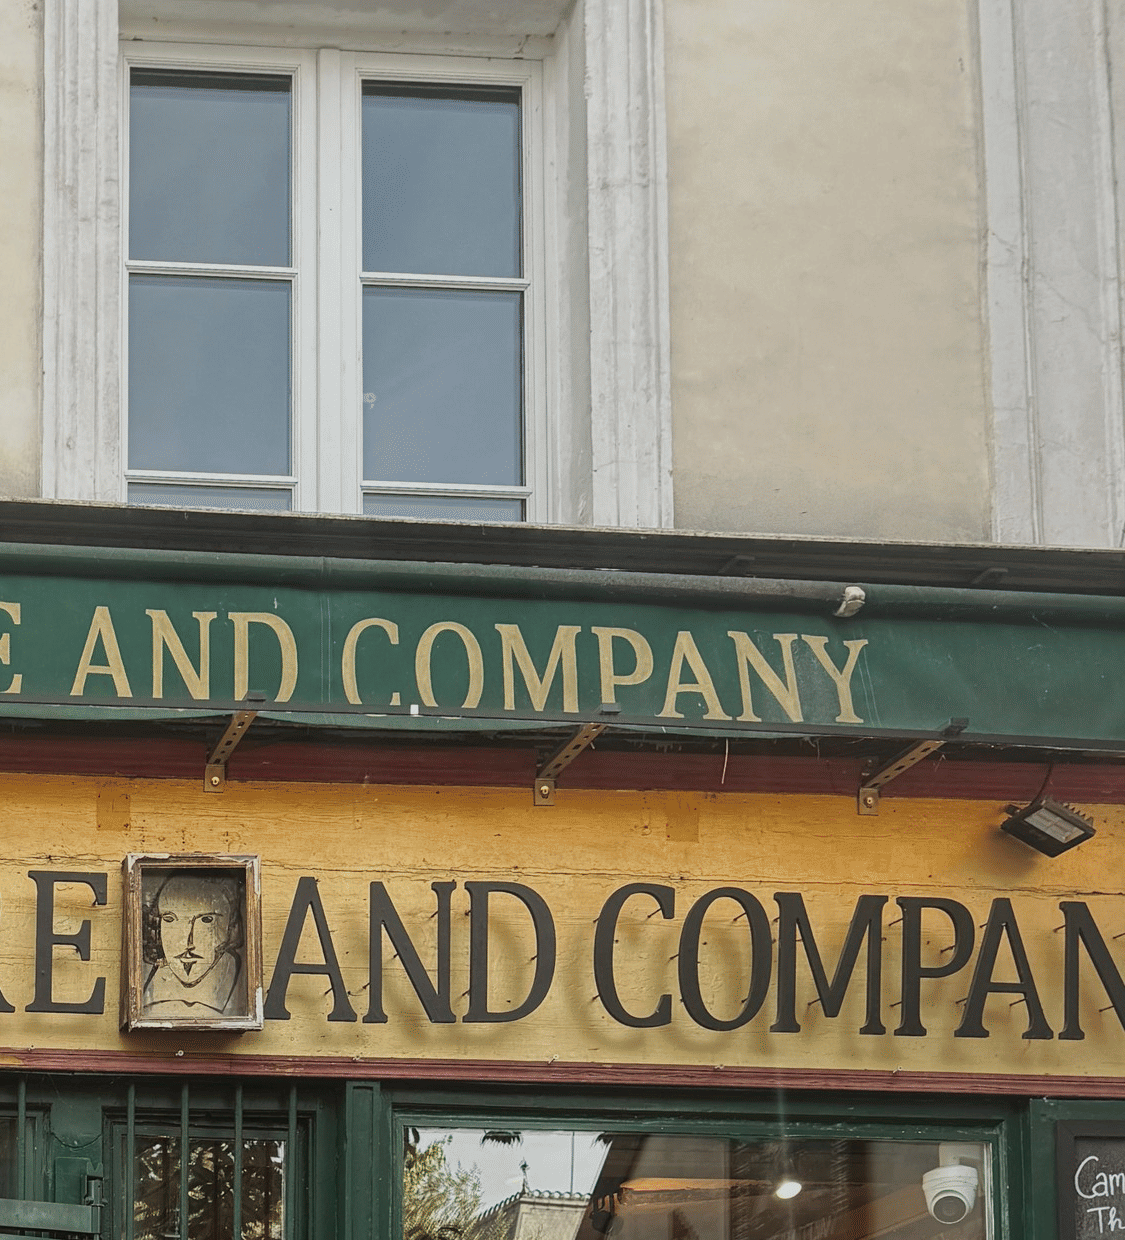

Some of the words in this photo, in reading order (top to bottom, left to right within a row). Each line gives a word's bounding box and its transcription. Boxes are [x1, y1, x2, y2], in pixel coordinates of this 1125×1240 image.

[70, 605, 298, 703] AND
[341, 617, 869, 724] COMPANY
[263, 876, 556, 1025] AND
[593, 881, 1125, 1041] COMPAN
[1075, 1155, 1125, 1199] Cam
